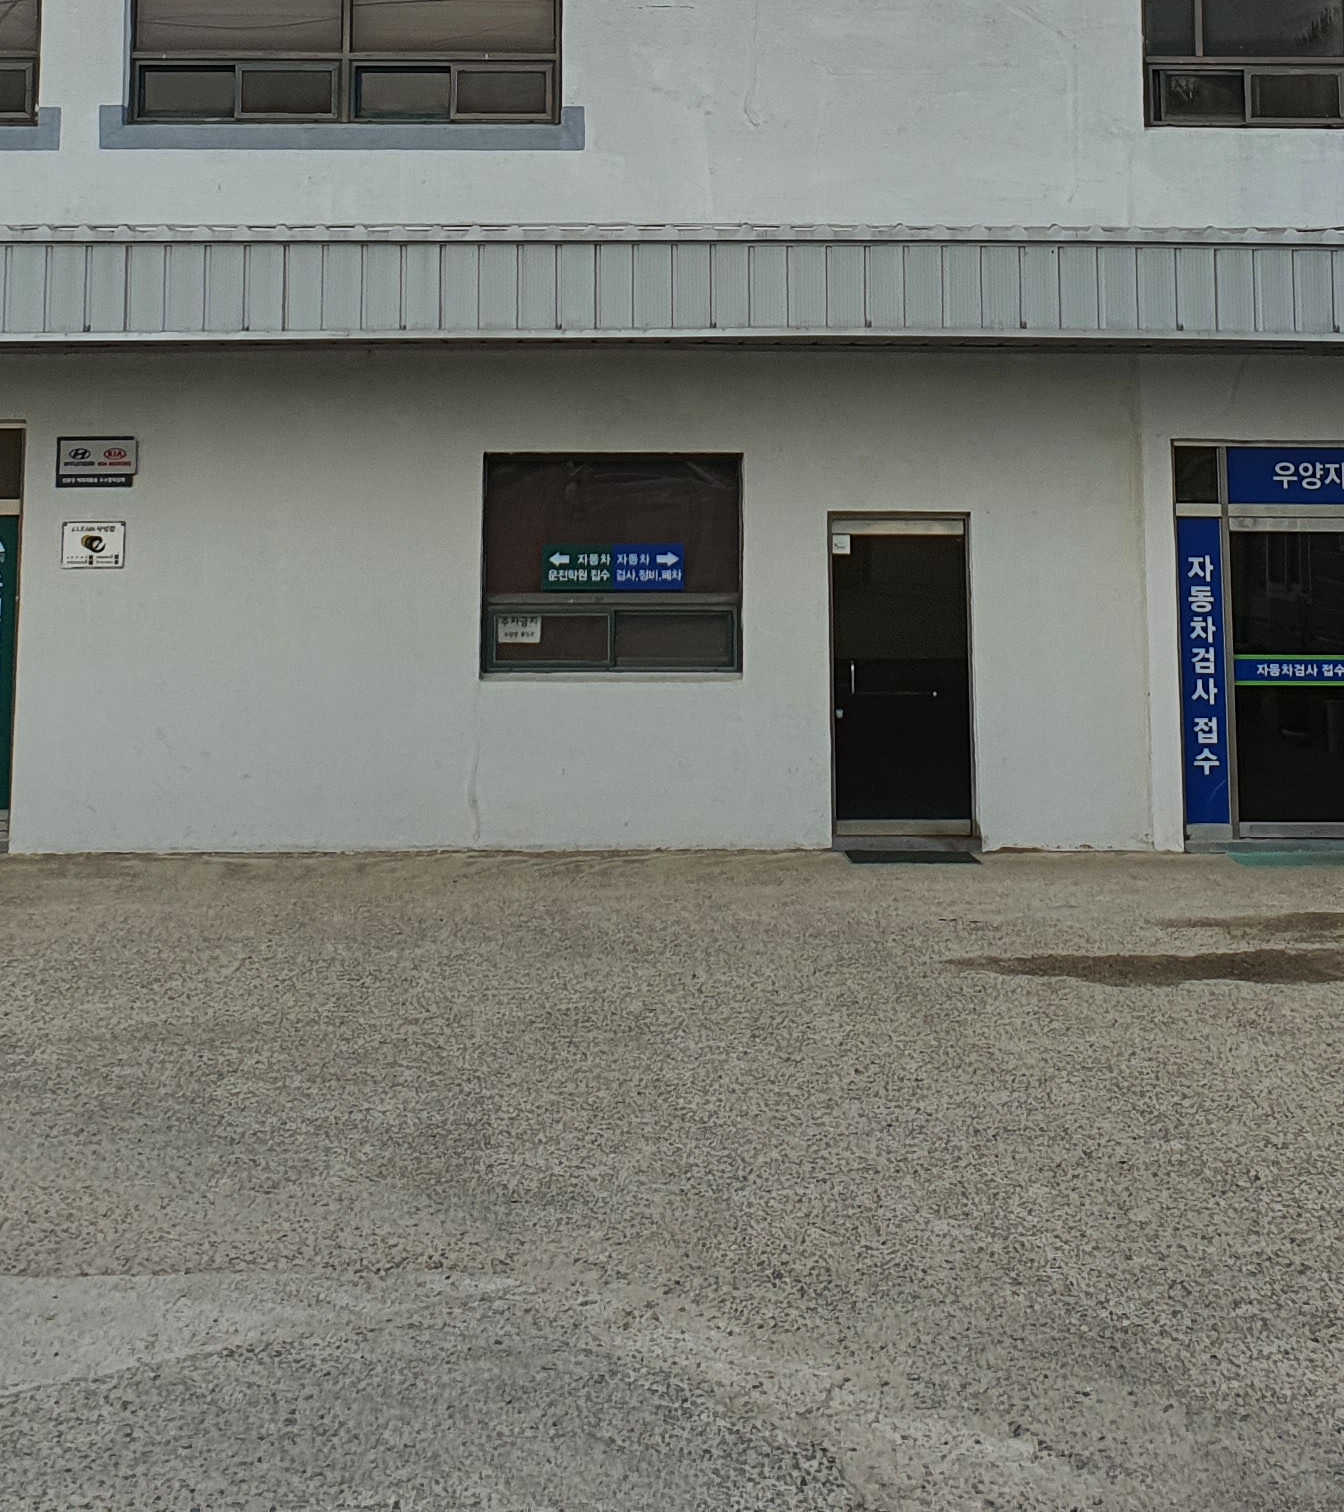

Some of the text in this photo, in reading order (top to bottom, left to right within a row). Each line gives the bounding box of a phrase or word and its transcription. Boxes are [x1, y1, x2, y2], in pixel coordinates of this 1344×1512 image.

[577, 553, 611, 567] 자동차
[616, 553, 651, 567] 자동차
[1187, 553, 1221, 777] 자동차검사 접수
[1256, 663, 1319, 678] 자동차검사
